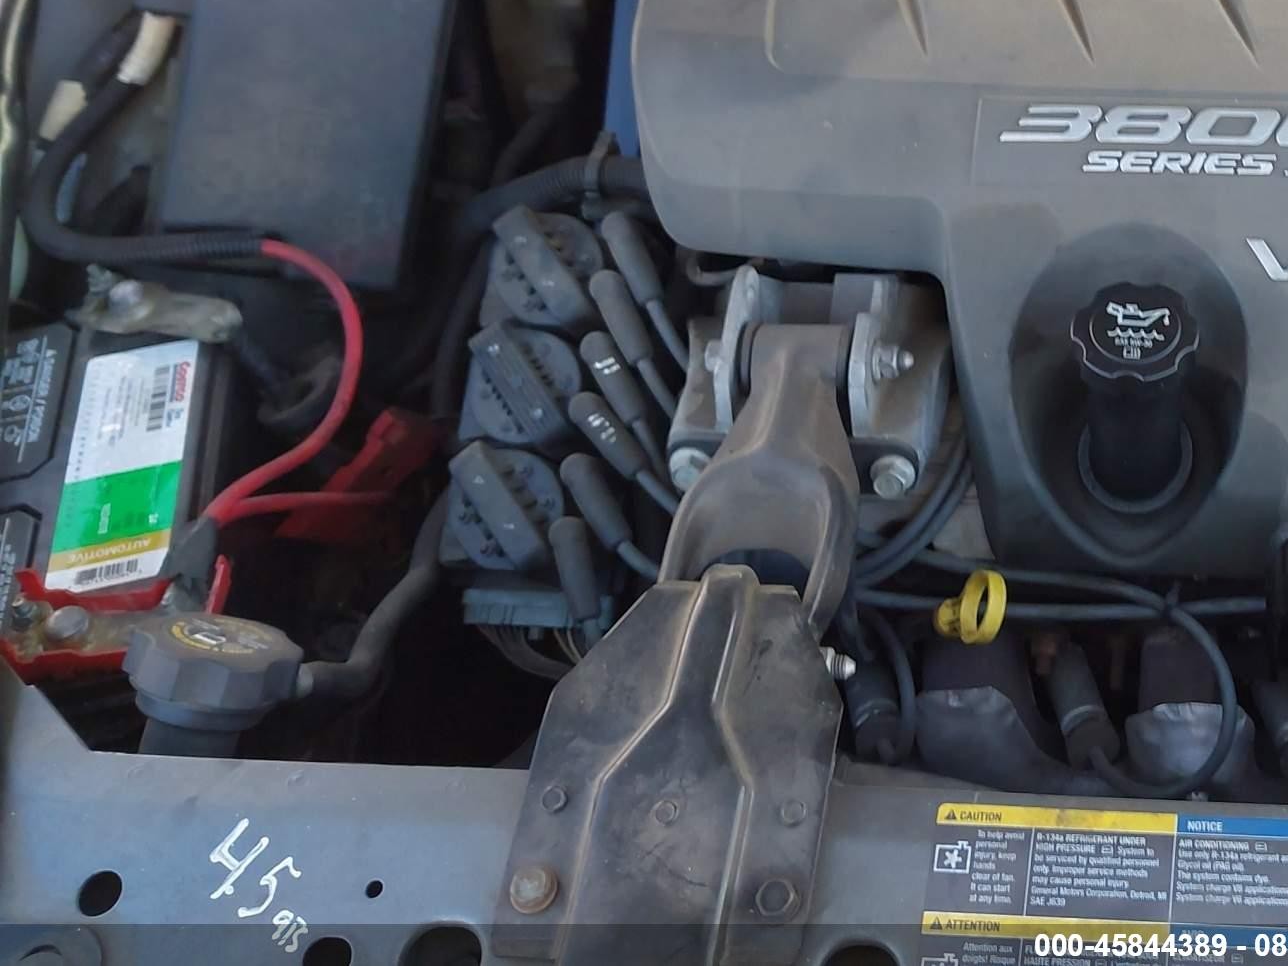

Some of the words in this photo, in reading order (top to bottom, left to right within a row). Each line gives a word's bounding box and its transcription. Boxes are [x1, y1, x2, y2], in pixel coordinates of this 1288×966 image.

[1082, 150, 1277, 177] SERIES
[67, 538, 151, 563] AUTOMOTIVE
[959, 810, 1002, 822] CAUTION
[1187, 820, 1223, 832] NOTICE
[975, 839, 1007, 849] personal
[1065, 833, 1117, 844] REFRIGERANT
[1119, 836, 1145, 845] UNDER
[1178, 838, 1192, 847] AIR
[1194, 839, 1249, 850] CONDITIONING
[1036, 842, 1054, 851] HIGH
[1056, 843, 1094, 853] PRESSURE
[1117, 846, 1144, 856] System
[209, 818, 302, 918] 45
[971, 871, 989, 880] clear
[992, 872, 999, 880] of
[977, 883, 991, 891] can
[993, 883, 1009, 892] start
[1032, 876, 1048, 885] may
[1049, 876, 1071, 884] cause
[1073, 876, 1105, 888] personal
[1060, 886, 1084, 896] Motors
[978, 894, 992, 903] any
[1030, 896, 1044, 905] SAE
[945, 918, 1000, 932] ATTENTION
[963, 942, 997, 952] Attention
